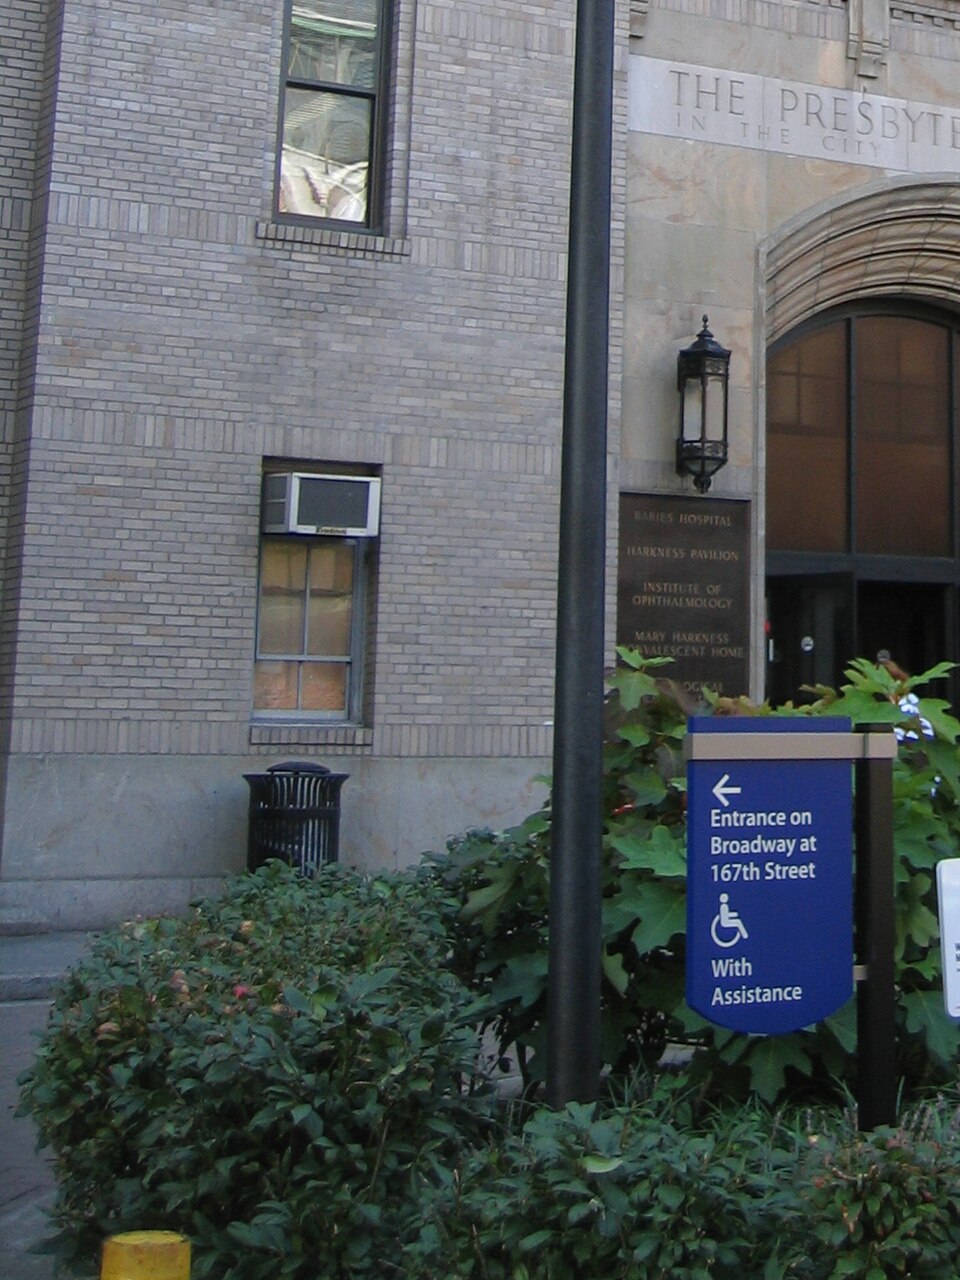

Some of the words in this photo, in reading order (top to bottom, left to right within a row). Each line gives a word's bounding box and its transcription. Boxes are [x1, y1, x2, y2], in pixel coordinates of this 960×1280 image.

[669, 69, 745, 116] THE
[675, 113, 708, 133] IN
[738, 121, 791, 146] THE
[821, 134, 881, 159] CITY
[680, 513, 731, 527] HOSPITAL
[627, 545, 684, 560] HARKNESS
[690, 549, 739, 562] PAVILION
[644, 581, 700, 595] INSTITUTE
[707, 584, 721, 596] OF
[635, 631, 666, 642] MARY
[672, 632, 730, 644] HARKNESS
[711, 646, 744, 658] HOME
[710, 807, 787, 828] Entrance
[790, 810, 812, 826] on
[710, 836, 797, 858] Broadway
[799, 835, 817, 853] at
[710, 862, 761, 883] 167th
[764, 861, 816, 881] Street
[711, 956, 753, 979] With
[711, 984, 803, 1007] Assistance
